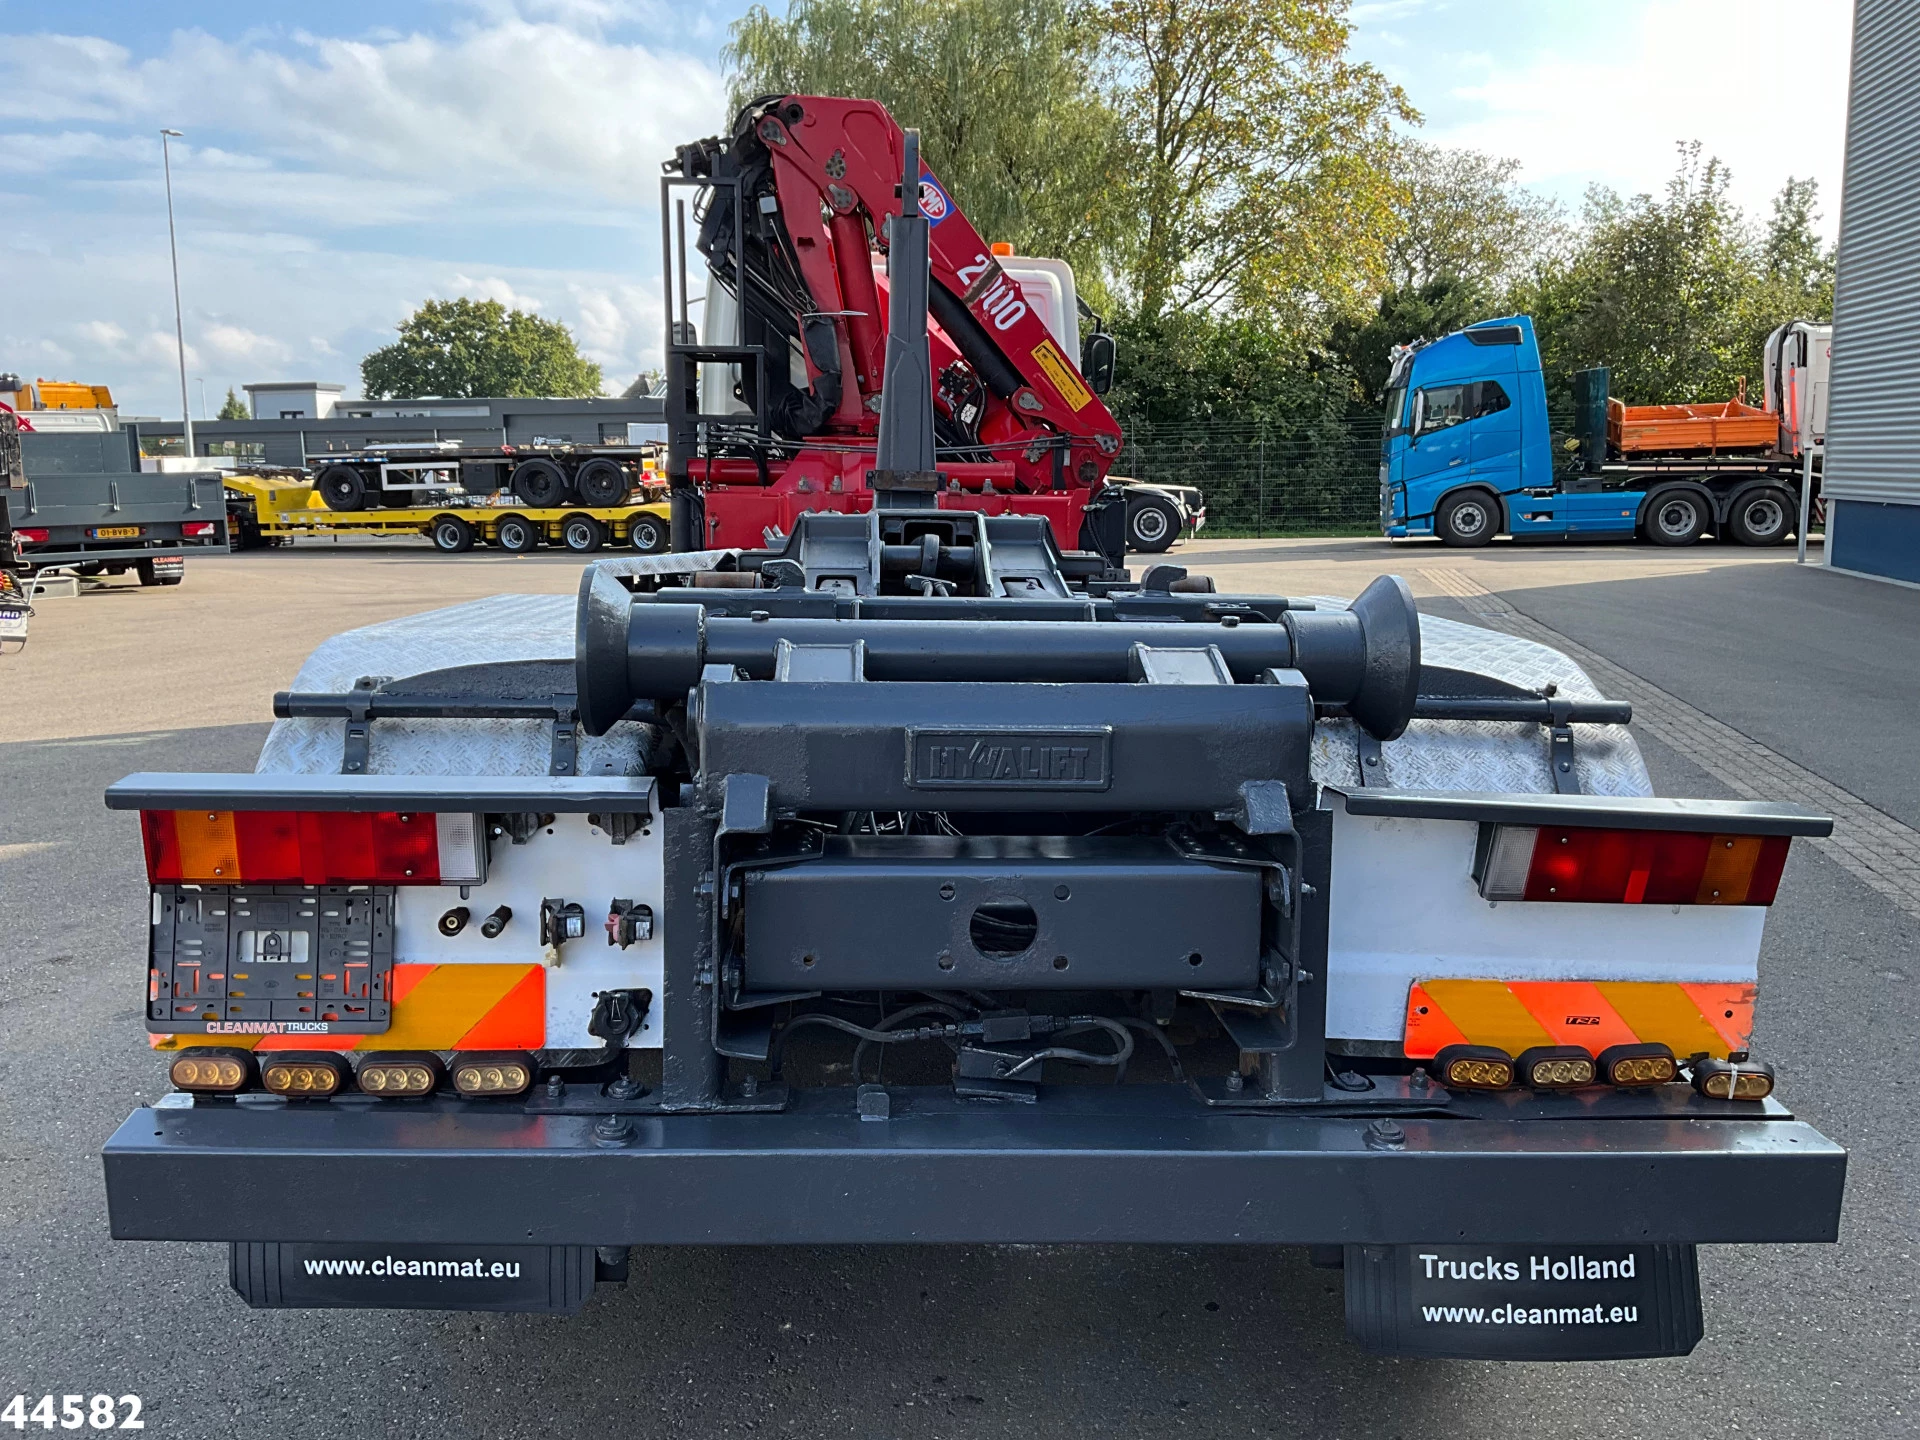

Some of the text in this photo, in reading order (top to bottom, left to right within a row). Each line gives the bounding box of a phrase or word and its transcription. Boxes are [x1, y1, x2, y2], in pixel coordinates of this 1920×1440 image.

[206, 1021, 329, 1034] CLEANMAT TRUCKS
[304, 1255, 521, 1278] www.cleanmat.eu
[1419, 1253, 1636, 1281] Trucks Holland
[1422, 1303, 1638, 1324] www.cleanmat.eu
